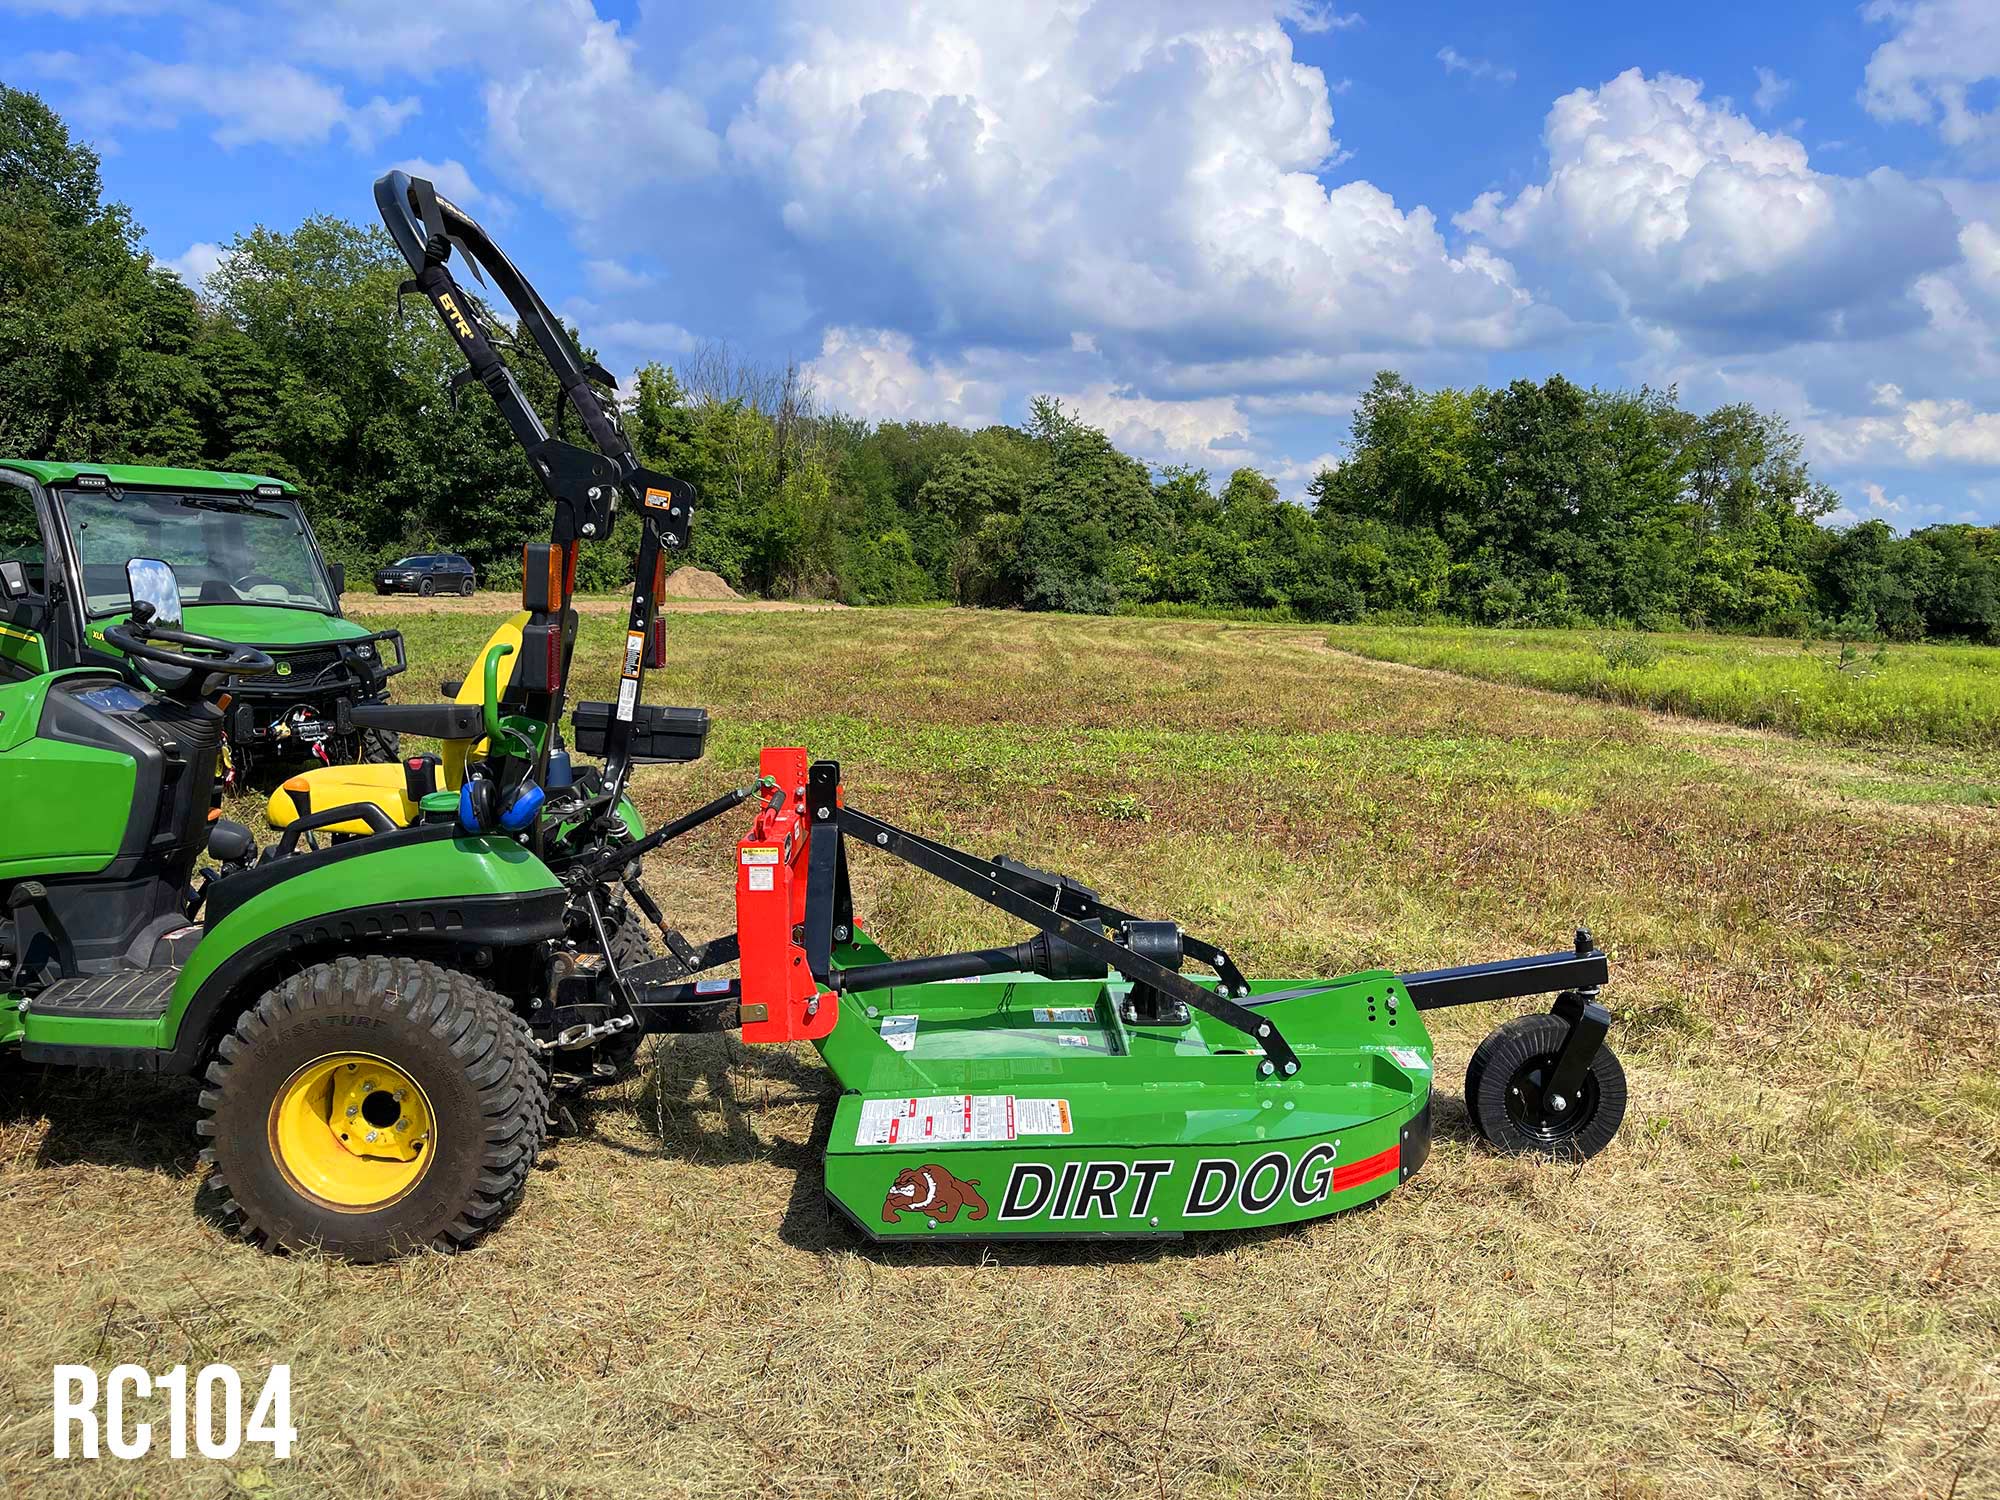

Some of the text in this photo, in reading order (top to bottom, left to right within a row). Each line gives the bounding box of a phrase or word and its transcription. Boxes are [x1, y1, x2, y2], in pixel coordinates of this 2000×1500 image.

[439, 293, 472, 338] BTR
[997, 1142, 1337, 1221] DIRT DOG
